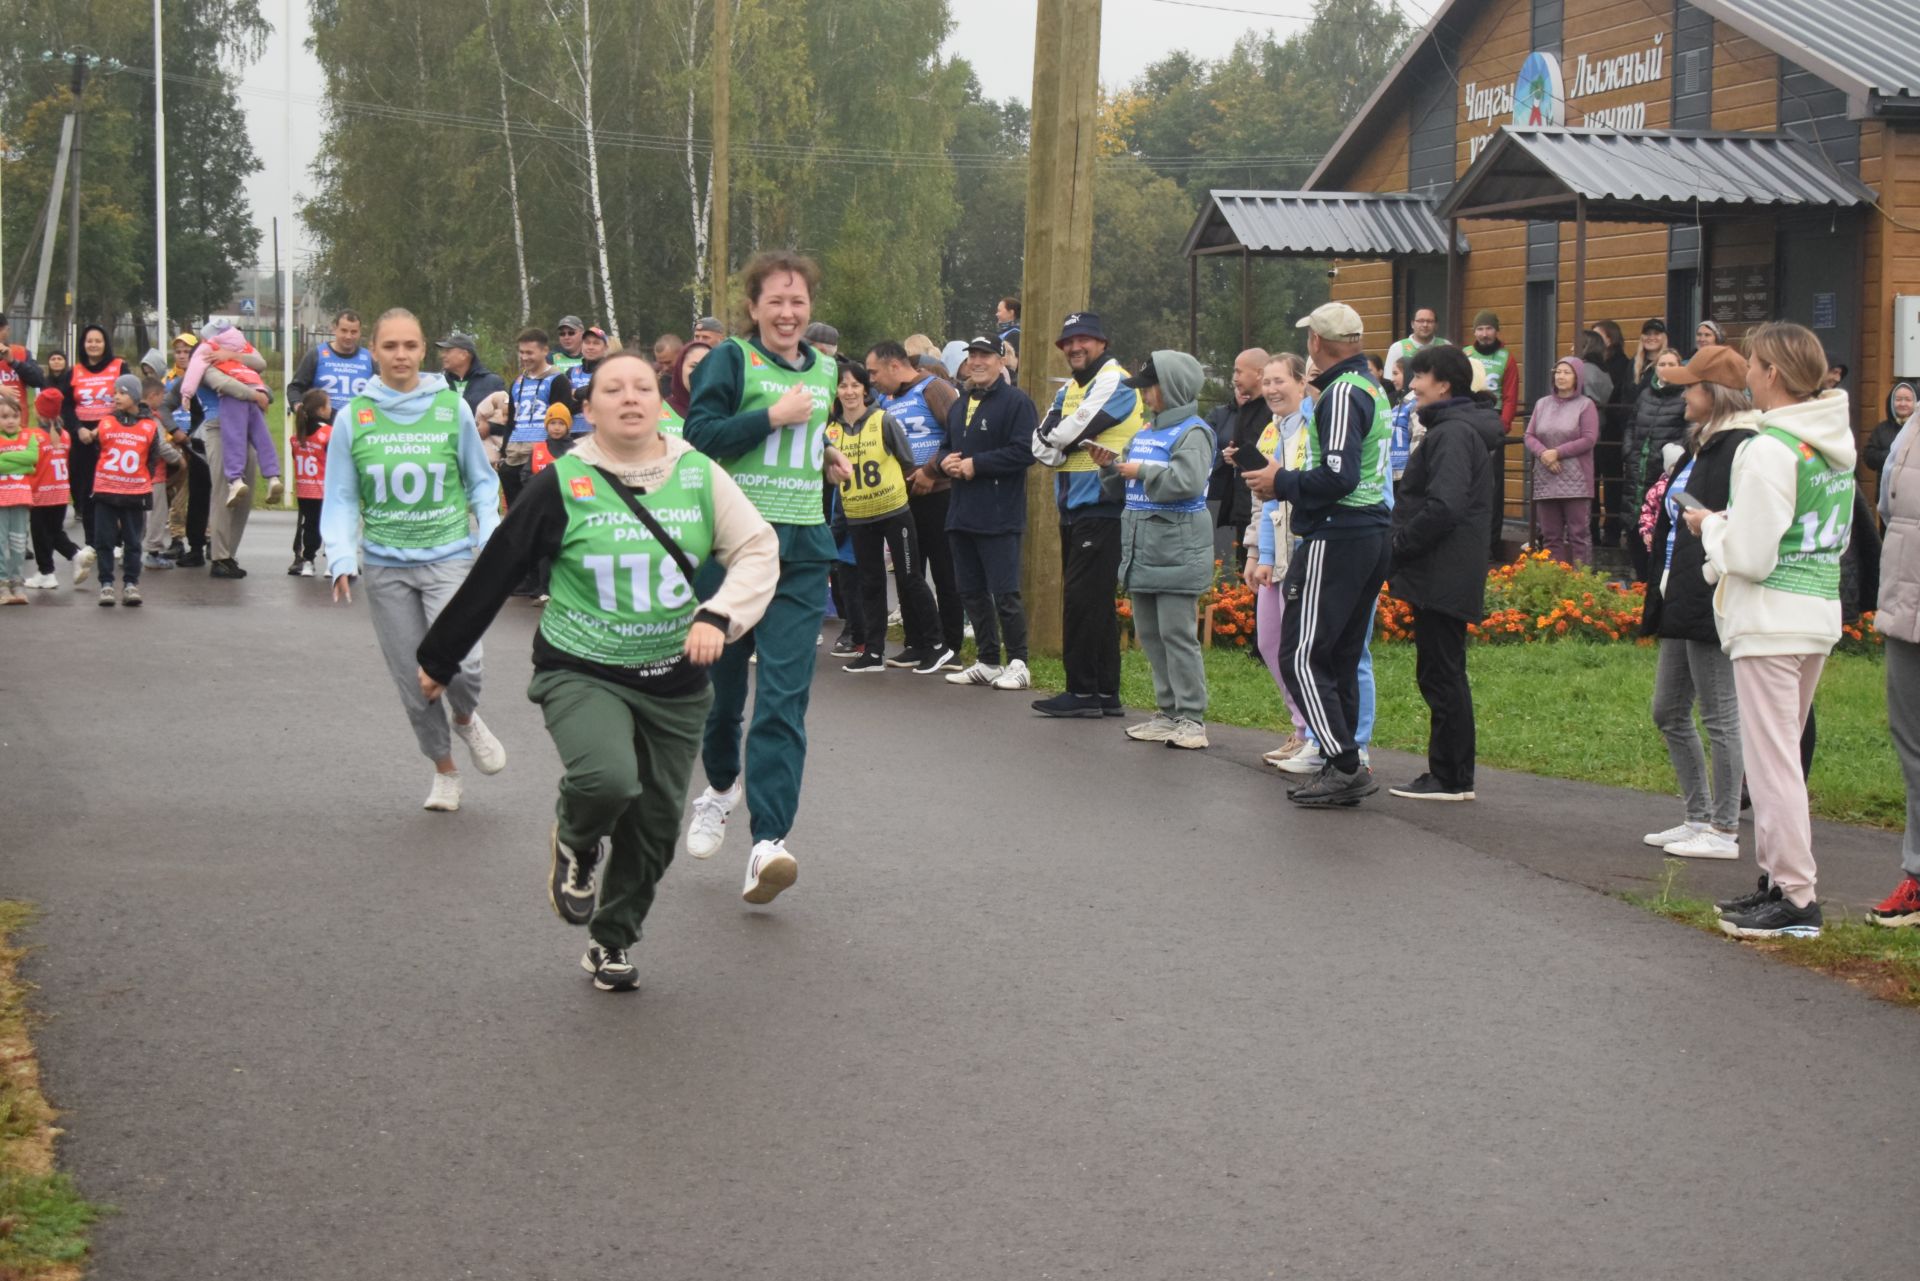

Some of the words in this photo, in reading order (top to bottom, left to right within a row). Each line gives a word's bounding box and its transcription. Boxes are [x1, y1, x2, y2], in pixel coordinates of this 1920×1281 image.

[1571, 32, 1663, 98] Лыжный
[365, 432, 448, 445] ТУКАЕВСКИЙ
[384, 442, 431, 455] РАЙОН
[103, 447, 140, 474] 20
[296, 455, 318, 477] 16
[366, 461, 447, 505] 101
[613, 526, 683, 542] РАЙН
[583, 552, 699, 613] 118
